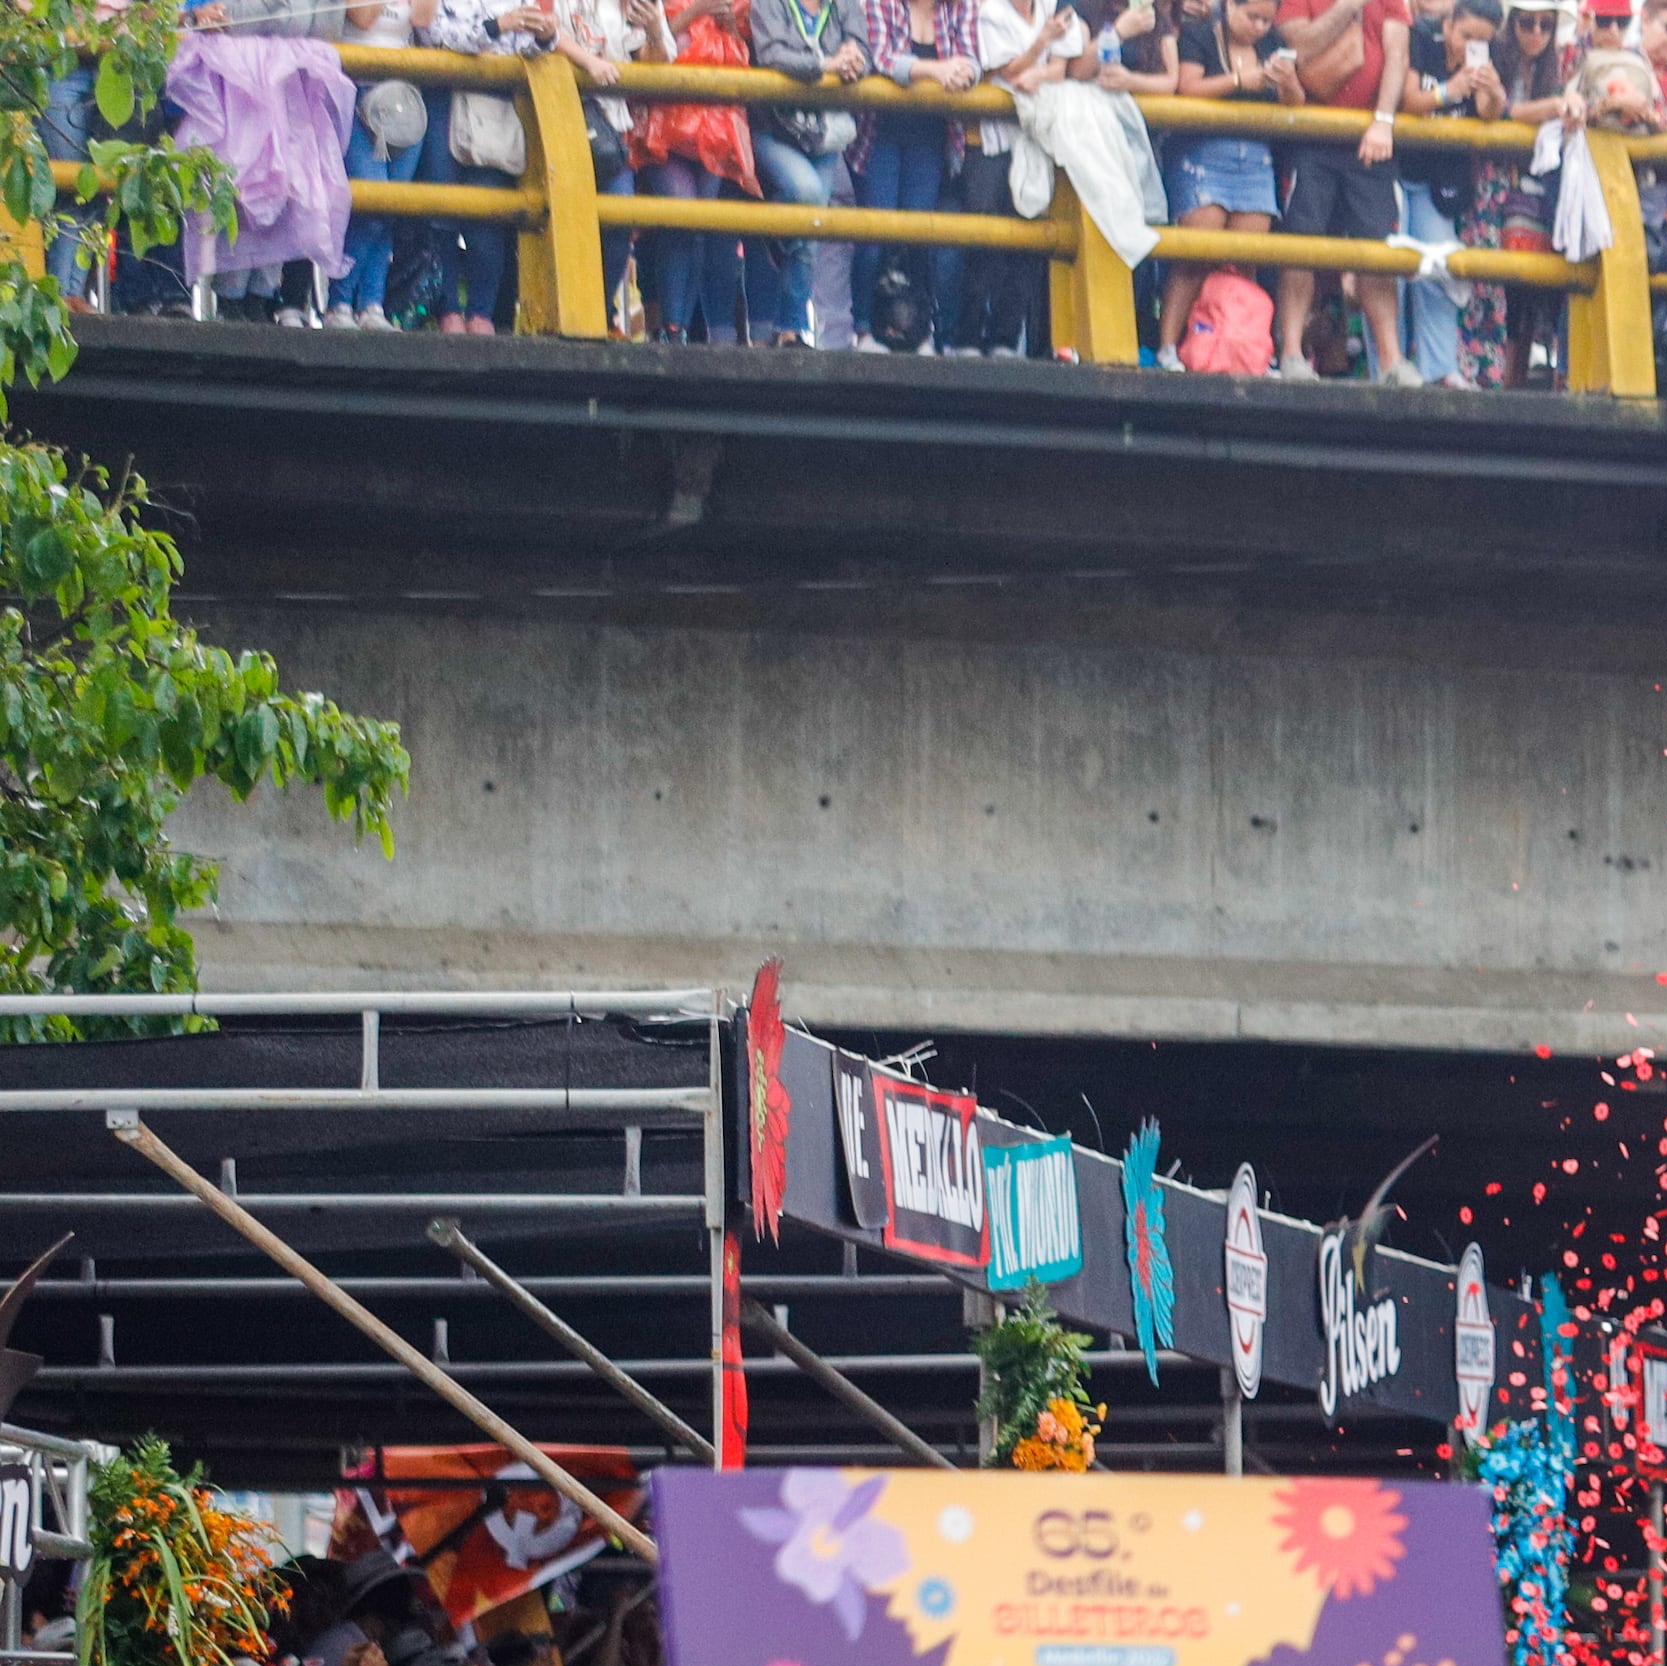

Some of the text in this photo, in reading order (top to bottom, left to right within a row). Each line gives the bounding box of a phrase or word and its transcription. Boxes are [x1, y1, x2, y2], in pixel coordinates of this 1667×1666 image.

[885, 1097, 984, 1233] MEDALLO
[1319, 1229, 1401, 1417] Pilsen
[1026, 1570, 1139, 1597] Desfile
